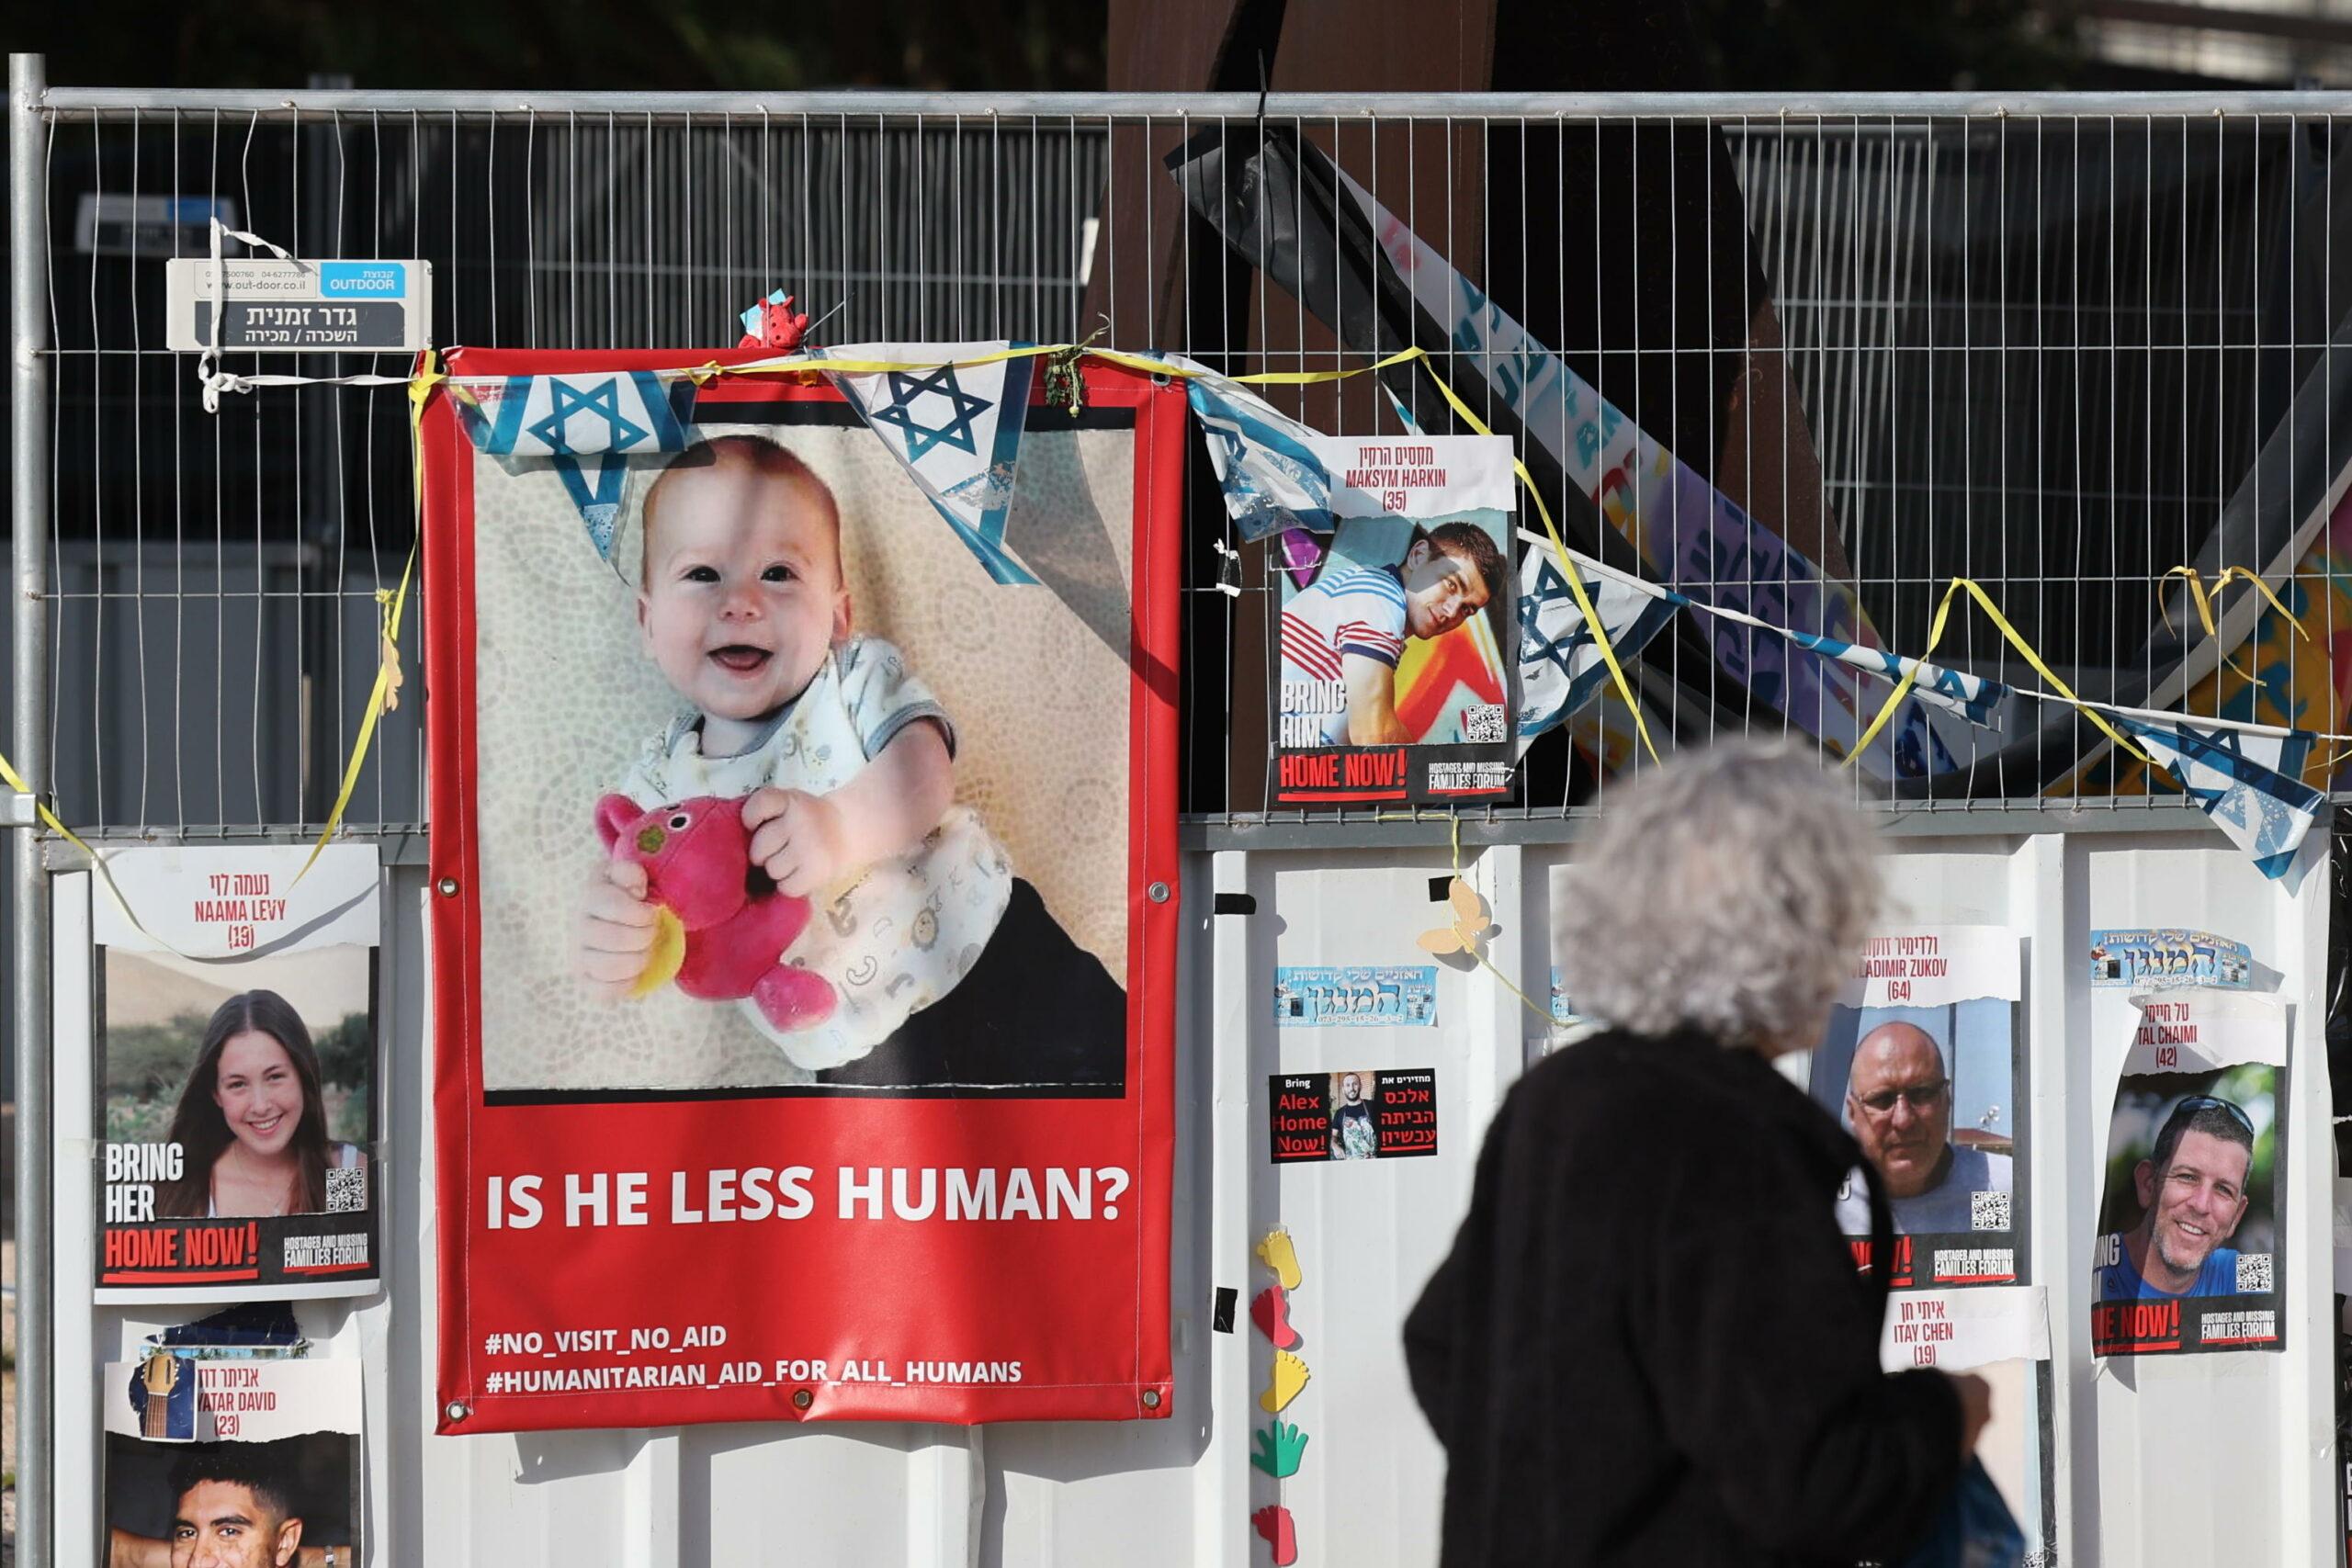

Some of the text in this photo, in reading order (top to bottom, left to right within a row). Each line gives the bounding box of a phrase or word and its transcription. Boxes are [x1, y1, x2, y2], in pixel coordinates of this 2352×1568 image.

[207, 279, 306, 290] ww.out-door.co.il
[330, 279, 395, 290] OUTDOOR
[363, 270, 394, 279] קבוצת
[246, 308, 357, 326] גדר זמנית
[245, 330, 290, 343] מכירה
[306, 329, 357, 343] השכרה
[1359, 446, 1433, 468] מקסים הרקין
[1345, 469, 1446, 488] MAKSYM HARKIN
[1382, 490, 1407, 512] (35)
[1280, 679, 1347, 714] BRING
[1280, 717, 1322, 749] HIM
[1279, 749, 1408, 787] HOME NOW!
[1429, 761, 1506, 774] HOSTAGES AND MISSING
[1429, 773, 1505, 790] FAMILIES FORUM
[209, 873, 269, 896] נעמה לוי
[195, 899, 287, 921] NAAMA LEVY
[228, 924, 255, 950] (19)
[1895, 934, 1939, 956] ולדימיר
[2161, 931, 2186, 943] שלי
[1910, 959, 1948, 977] ZUKOV
[2123, 942, 2218, 983] המנגן
[1347, 969, 1371, 981] שלי
[1887, 980, 1911, 1001] (64)
[1307, 981, 1401, 1022] המנגן
[2144, 1001, 2189, 1023] טל חיימי
[2138, 1025, 2198, 1045] TAL CHAIMI
[2155, 1046, 2177, 1067] (42)
[1285, 1078, 1311, 1089] Bring
[1382, 1075, 1431, 1085] מחזירים את
[1279, 1093, 1320, 1110] Alex
[1385, 1088, 1430, 1104] אלכס
[1272, 1115, 1328, 1132] Home
[1381, 1110, 1434, 1125] הביתה
[1278, 1134, 1325, 1152] Now!
[1382, 1130, 1436, 1146] עכשיו!
[106, 1143, 183, 1182] BRING
[106, 1184, 155, 1223] HER
[486, 1166, 1130, 1229] IS HE LESS HUMAN?
[105, 1222, 258, 1268] HOME NOW!
[284, 1233, 368, 1250] HOSTAGES AND MISSING
[284, 1247, 368, 1267] FAMILIES FORUM
[1934, 1248, 2014, 1261] HOSTAGES AND MISSING
[1934, 1259, 2014, 1277] FAMILIES FORUM
[1900, 1301, 1945, 1323] איתי חן
[2120, 1299, 2180, 1338] NOW!
[2201, 1310, 2275, 1324] HOSTAGES AND MISSING
[1894, 1323, 1953, 1343] ITAY CHEN
[2201, 1321, 2276, 1339] FAMILIES FORUM
[485, 1325, 728, 1359] #NO_VISIT_NO_AID
[1914, 1344, 1937, 1367] (19)
[220, 1368, 259, 1388] אביתר
[485, 1359, 1023, 1394] #HUMANITARIAN_AID_FOR_ALL_HUMANS
[198, 1392, 276, 1413] YATAR DAVID
[214, 1415, 240, 1437] (23)
